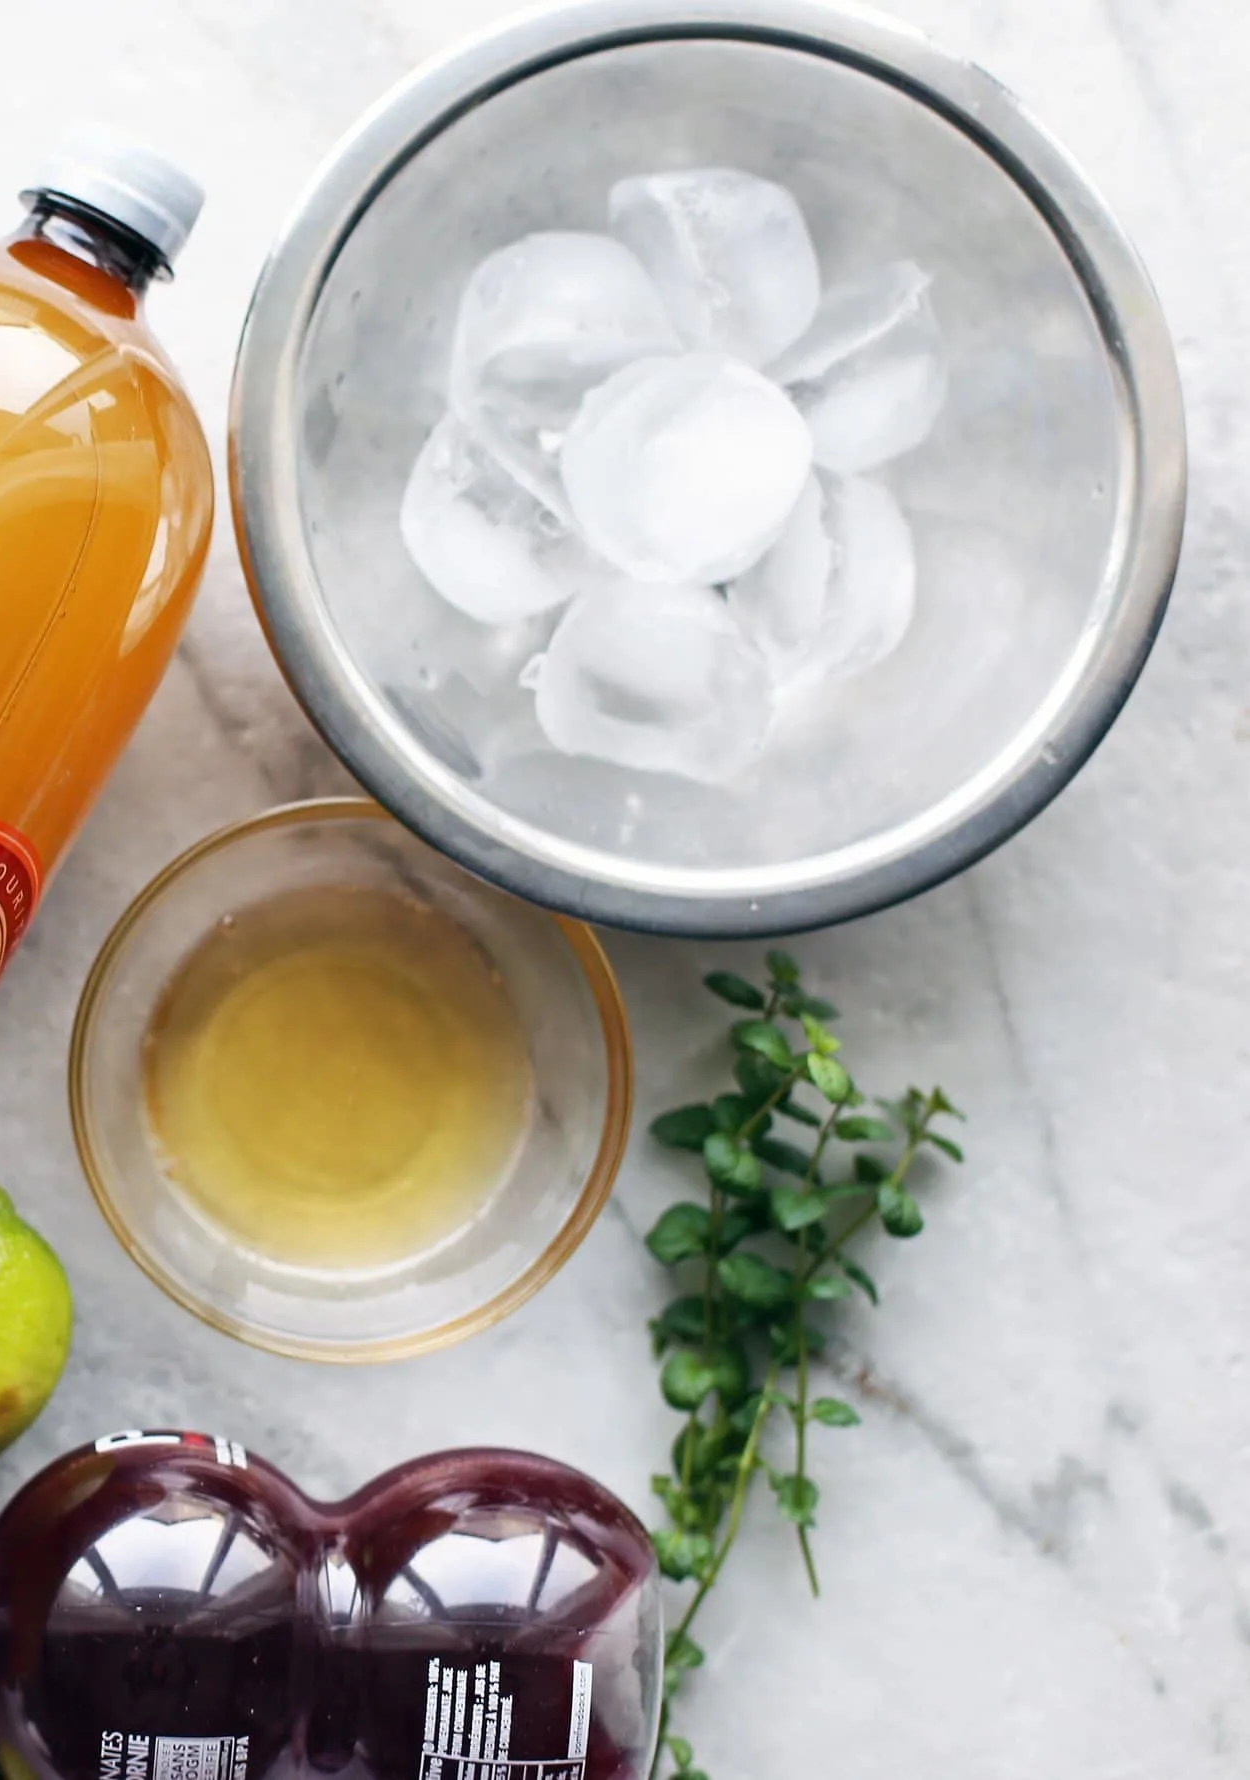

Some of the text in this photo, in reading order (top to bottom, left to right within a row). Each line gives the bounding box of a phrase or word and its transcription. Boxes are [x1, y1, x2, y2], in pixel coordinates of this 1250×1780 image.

[100, 1731, 124, 1780] NATES
[126, 1735, 150, 1780] ORNIE
[170, 1744, 186, 1780] SANS
